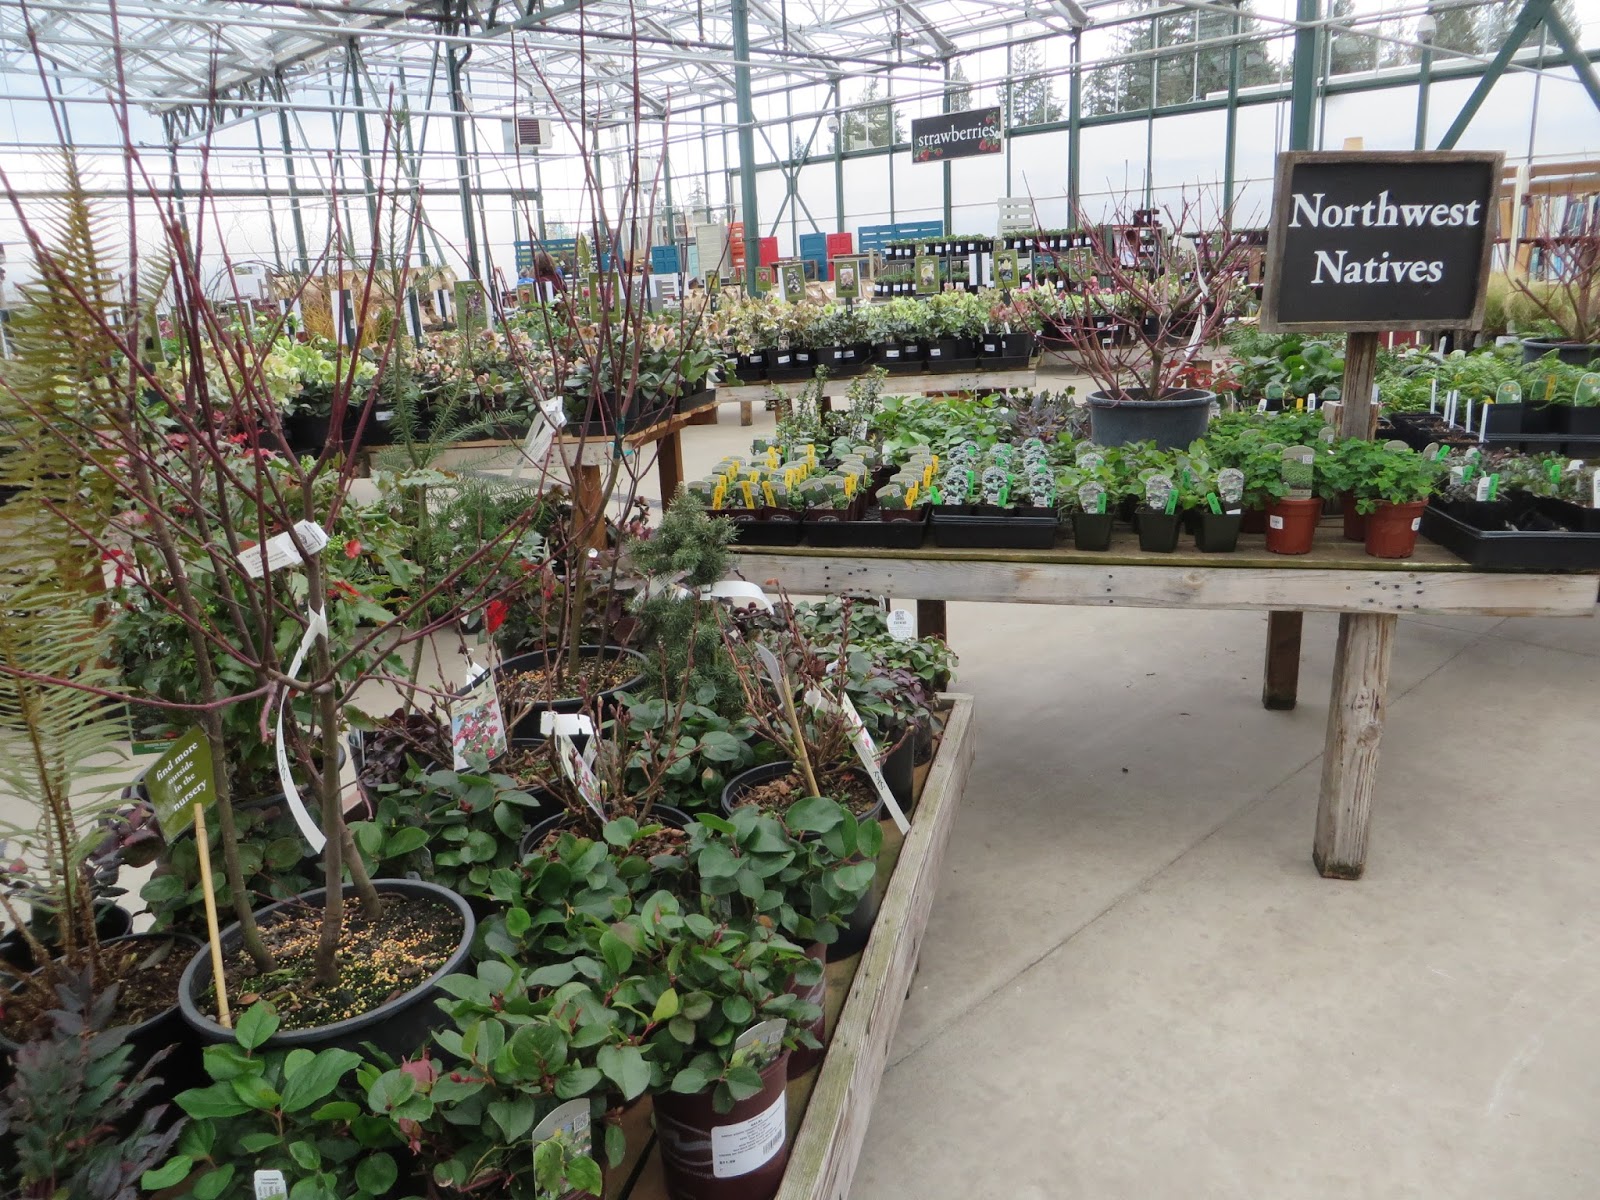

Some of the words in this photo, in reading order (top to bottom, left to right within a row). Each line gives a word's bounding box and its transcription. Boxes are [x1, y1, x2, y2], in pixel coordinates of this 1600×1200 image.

[918, 122, 995, 147] strawberries
[1288, 189, 1480, 228] Northwest
[1310, 250, 1444, 284] Natives
[156, 759, 174, 782] find
[174, 742, 199, 765] more
[168, 760, 194, 785] outside
[173, 778, 207, 812] nursery
[174, 784, 183, 794] in
[183, 773, 196, 786] the
